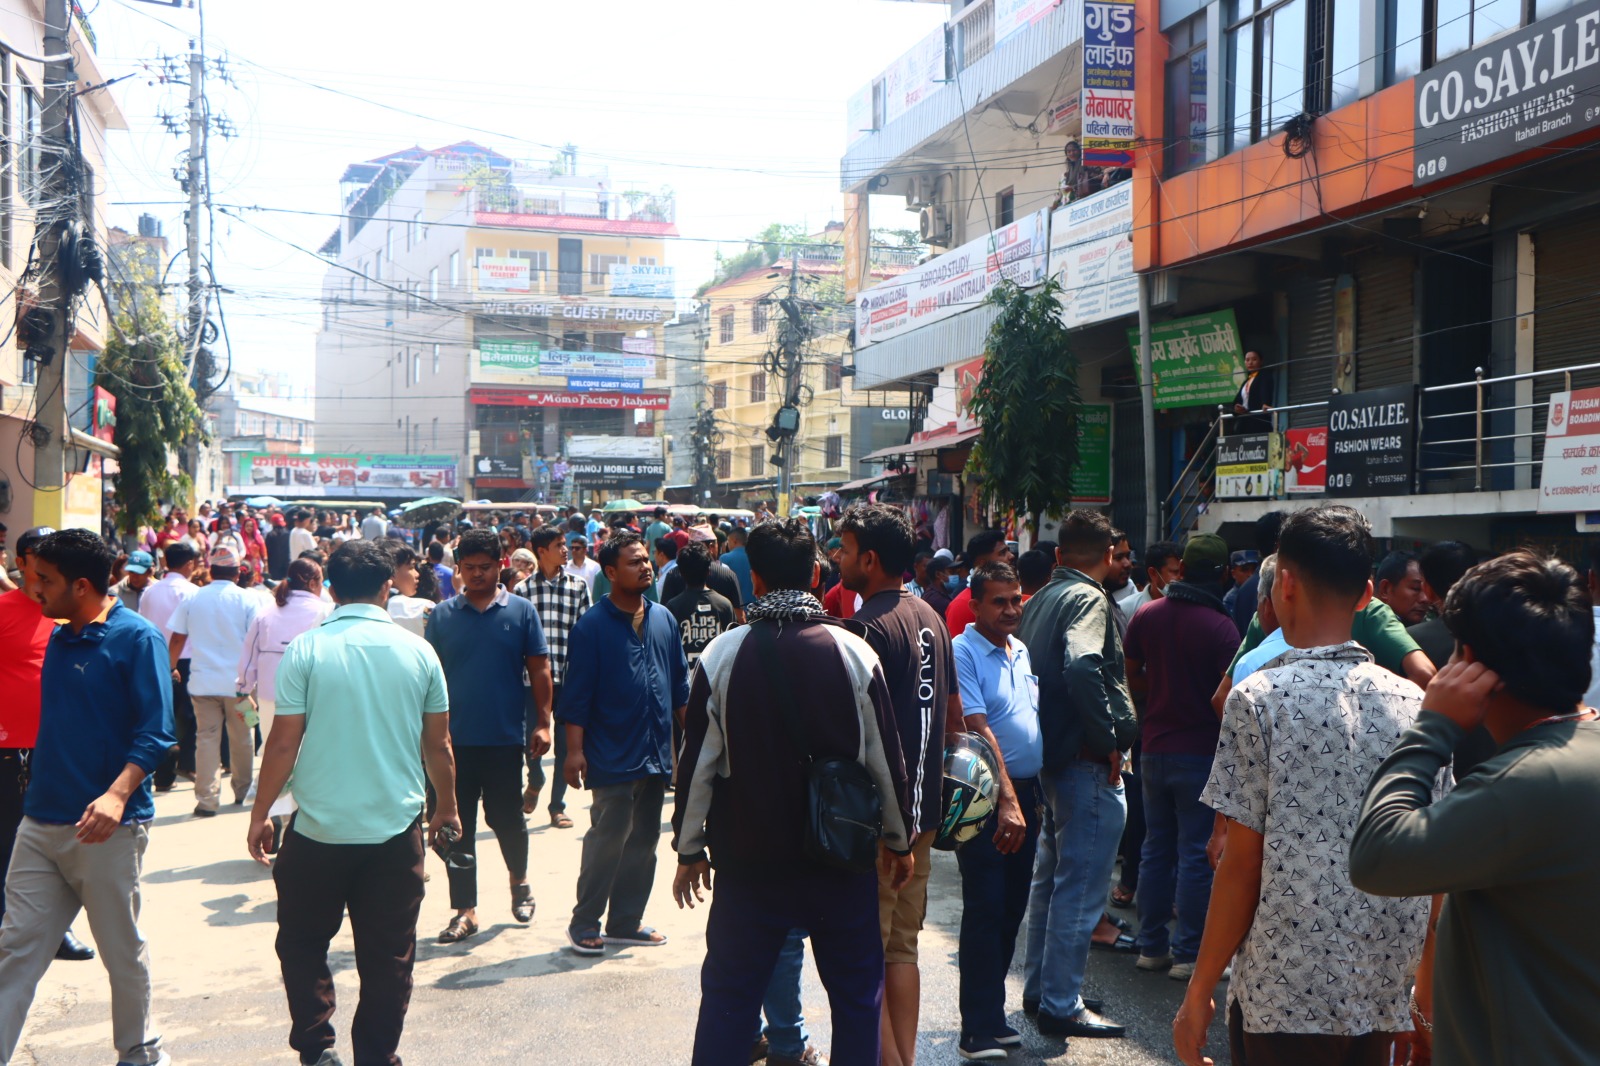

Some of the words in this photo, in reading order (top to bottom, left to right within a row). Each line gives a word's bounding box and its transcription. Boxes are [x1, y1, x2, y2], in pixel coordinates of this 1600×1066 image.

[1086, 2, 1134, 41] गुड
[1086, 41, 1134, 68] लाईफ
[1086, 90, 1133, 120] मेनपावर
[1460, 105, 1519, 144] FASHION
[1522, 85, 1574, 122] WEARS
[1086, 120, 1110, 136] पहिलो
[1112, 124, 1133, 136] तल्ला
[1515, 123, 1541, 142] Itahari
[1542, 113, 1572, 132] Branch
[631, 265, 652, 275] SKY
[654, 266, 674, 276] NET
[920, 265, 948, 291] ABROAD
[948, 254, 970, 278] STUDY
[889, 286, 908, 304] GLOBAL
[914, 296, 933, 318] JAPAN
[952, 274, 986, 302] AUSTRALIA
[482, 303, 554, 317] WELCOME
[563, 306, 609, 320] GUEST
[615, 308, 661, 322] HOUSE
[570, 380, 600, 388] WELCOME
[600, 380, 620, 388] GUEST
[579, 394, 620, 407] Factory
[622, 394, 657, 407] Itahari
[1571, 398, 1600, 410] FUJISAN
[1330, 403, 1410, 432] CO.SAY.LEE.
[1238, 444, 1266, 462] Cosmetics
[1334, 438, 1369, 454] FASHION
[1370, 436, 1402, 451] WEARS
[1384, 454, 1403, 464] Branch
[604, 466, 636, 474] MOBILE
[638, 466, 664, 474] STORE
[690, 612, 716, 628] Los
[681, 618, 722, 648] Angel
